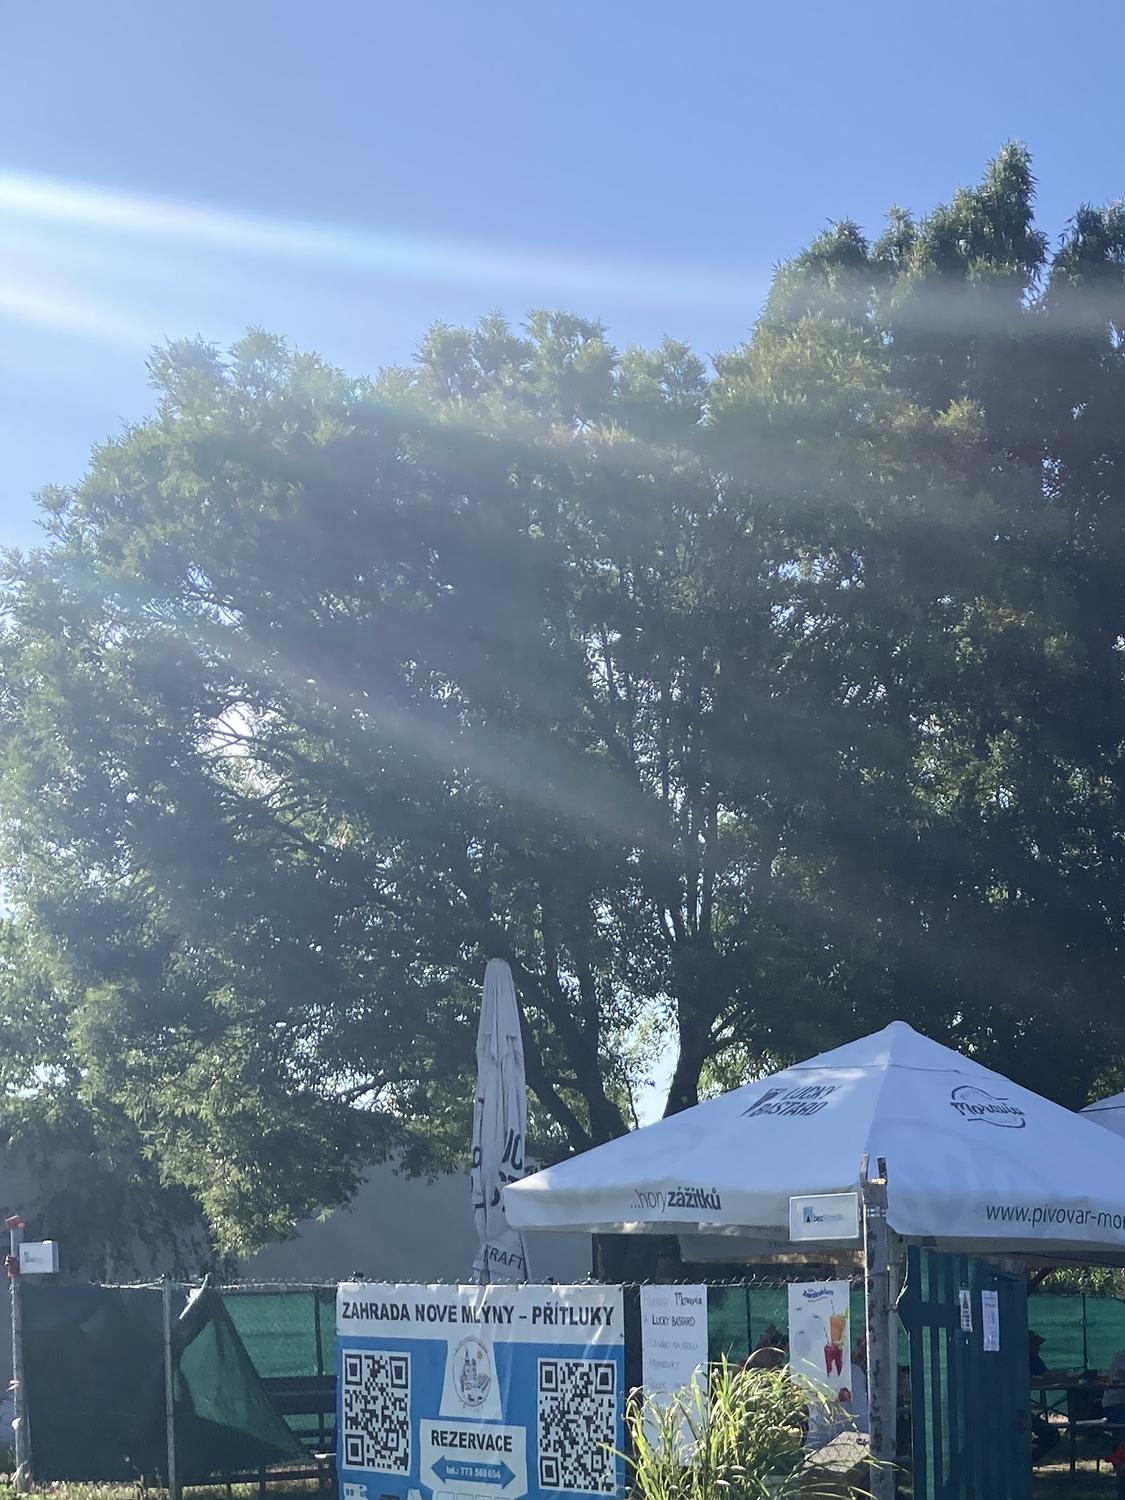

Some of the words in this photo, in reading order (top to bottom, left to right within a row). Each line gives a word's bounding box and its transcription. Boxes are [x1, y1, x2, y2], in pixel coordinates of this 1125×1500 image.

[781, 1086, 842, 1101] LUCKY
[748, 1101, 829, 1118] BASTARD
[950, 1101, 1025, 1116] Moravia
[342, 1302, 411, 1321] ZAHRADA
[461, 1301, 514, 1324] MLÝNY
[532, 1301, 615, 1326] PŘÍTLUKY
[431, 1429, 513, 1452] REZERVACE
